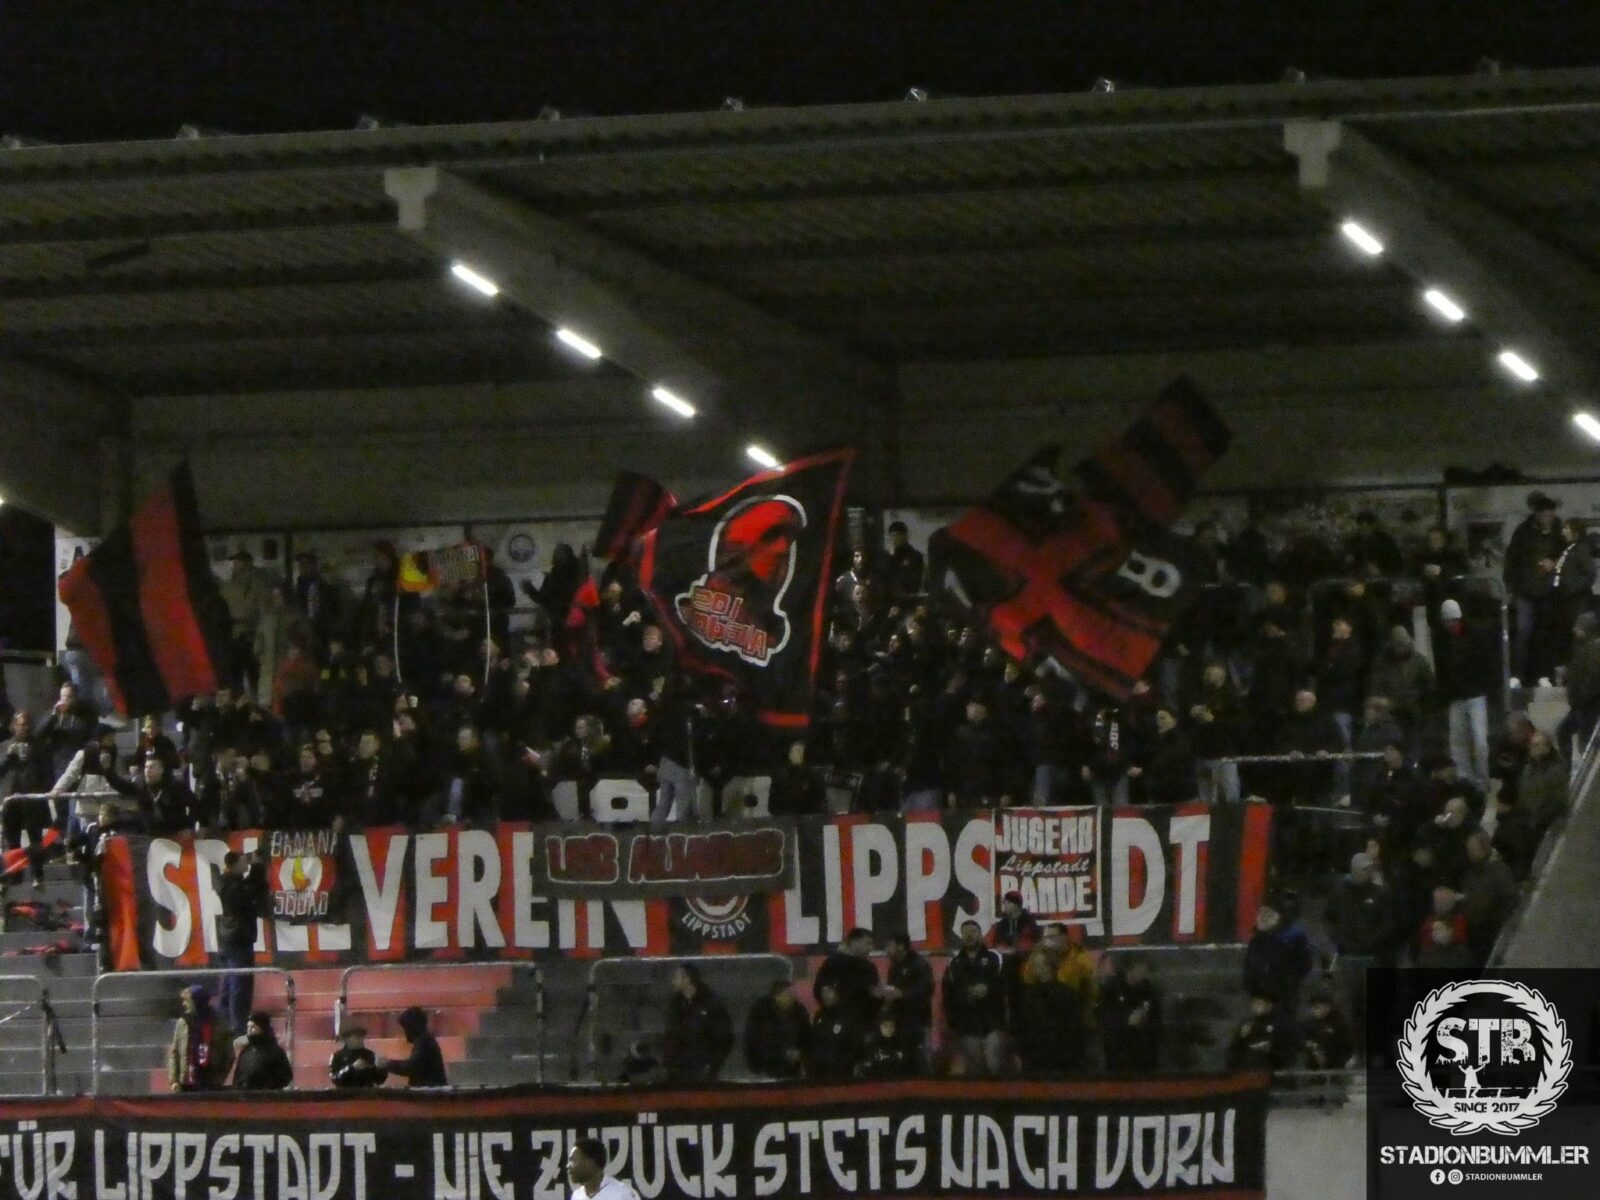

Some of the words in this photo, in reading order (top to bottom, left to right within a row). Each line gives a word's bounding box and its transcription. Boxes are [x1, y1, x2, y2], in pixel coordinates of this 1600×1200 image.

[995, 814, 1093, 855] JUGEND
[1000, 855, 1090, 877] Lippstadt
[273, 890, 329, 916] SQUAD
[681, 912, 752, 939] LIPPSTADT
[95, 1128, 376, 1200] LIPPSTADT
[433, 1131, 515, 1200] NIE
[753, 1114, 926, 1196] STETS
[941, 1113, 1078, 1190] NACH
[1095, 1108, 1236, 1189] VORN
